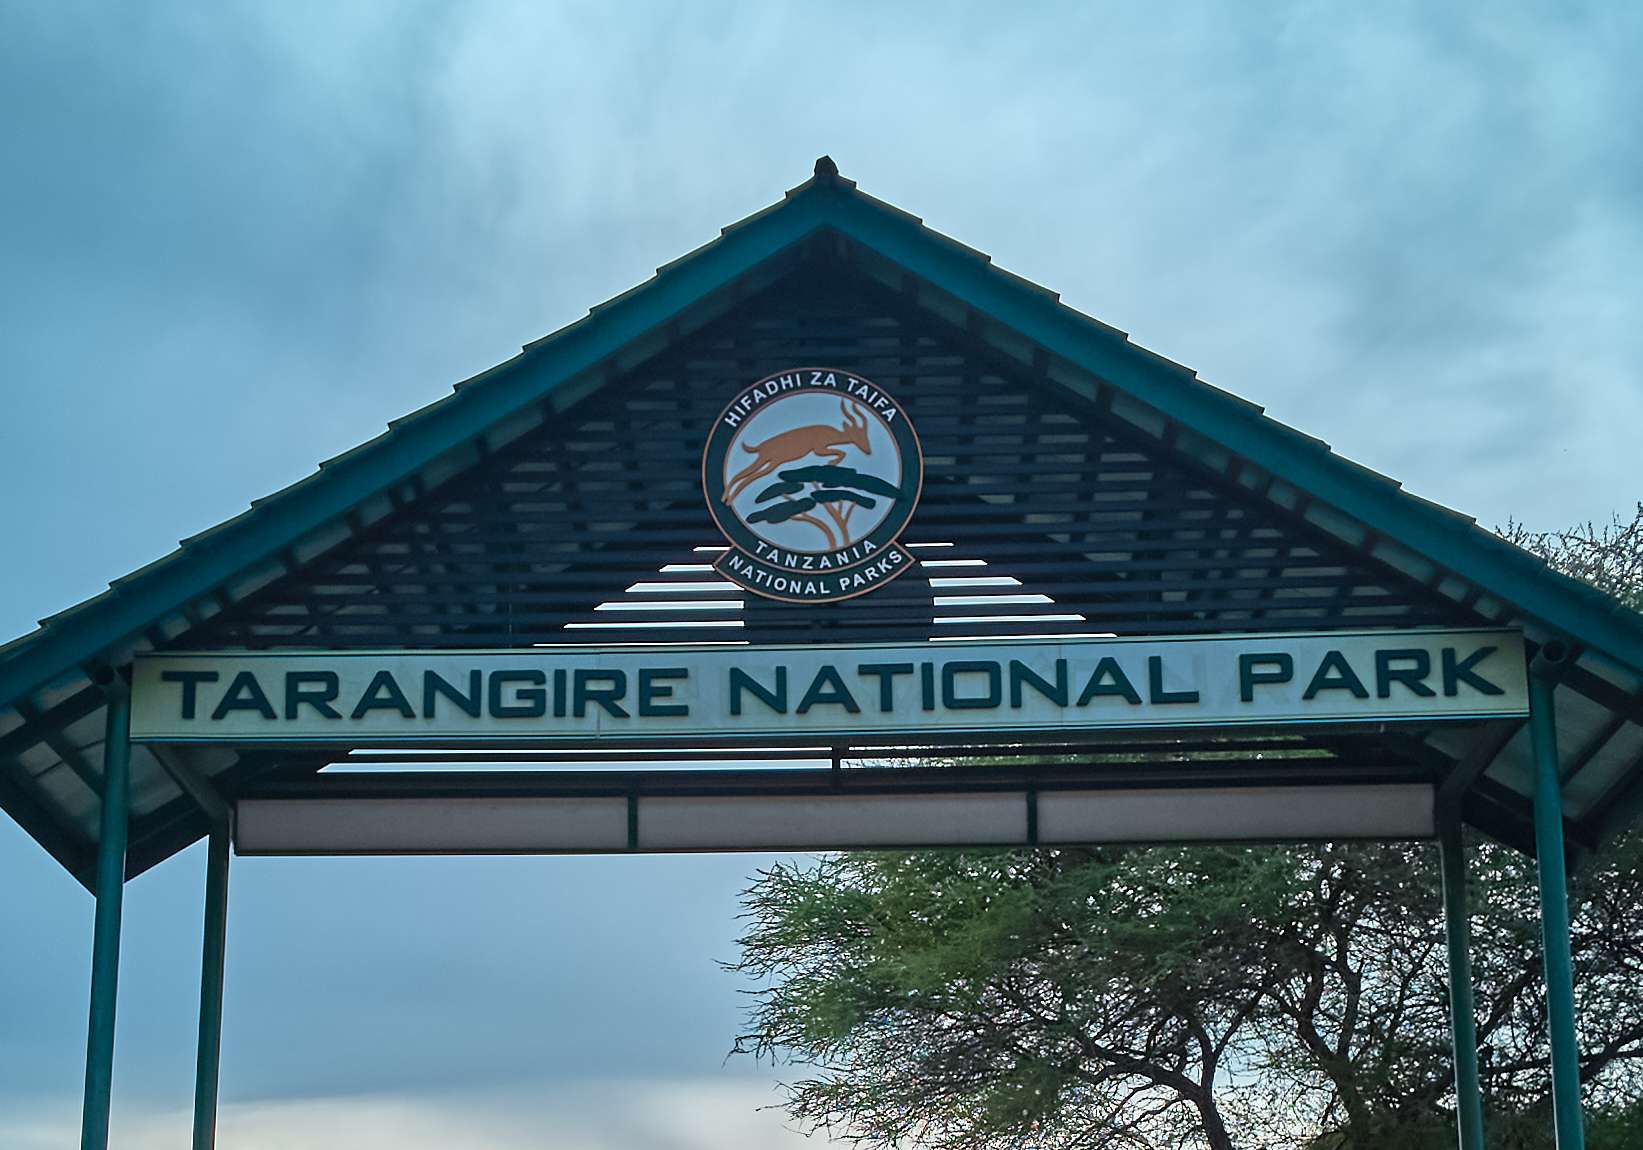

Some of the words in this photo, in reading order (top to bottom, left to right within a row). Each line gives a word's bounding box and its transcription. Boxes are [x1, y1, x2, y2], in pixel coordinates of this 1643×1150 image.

[724, 373, 801, 428] HIFADHI
[810, 371, 837, 387] ZA
[847, 377, 897, 423] TAIFA
[729, 555, 831, 595] NATIONAL
[839, 549, 902, 591] PARKS
[755, 539, 877, 570] TANZANIA
[161, 669, 690, 720] TARANGIRE
[729, 656, 1199, 716] NATIONAL
[1239, 645, 1506, 704] PARK
